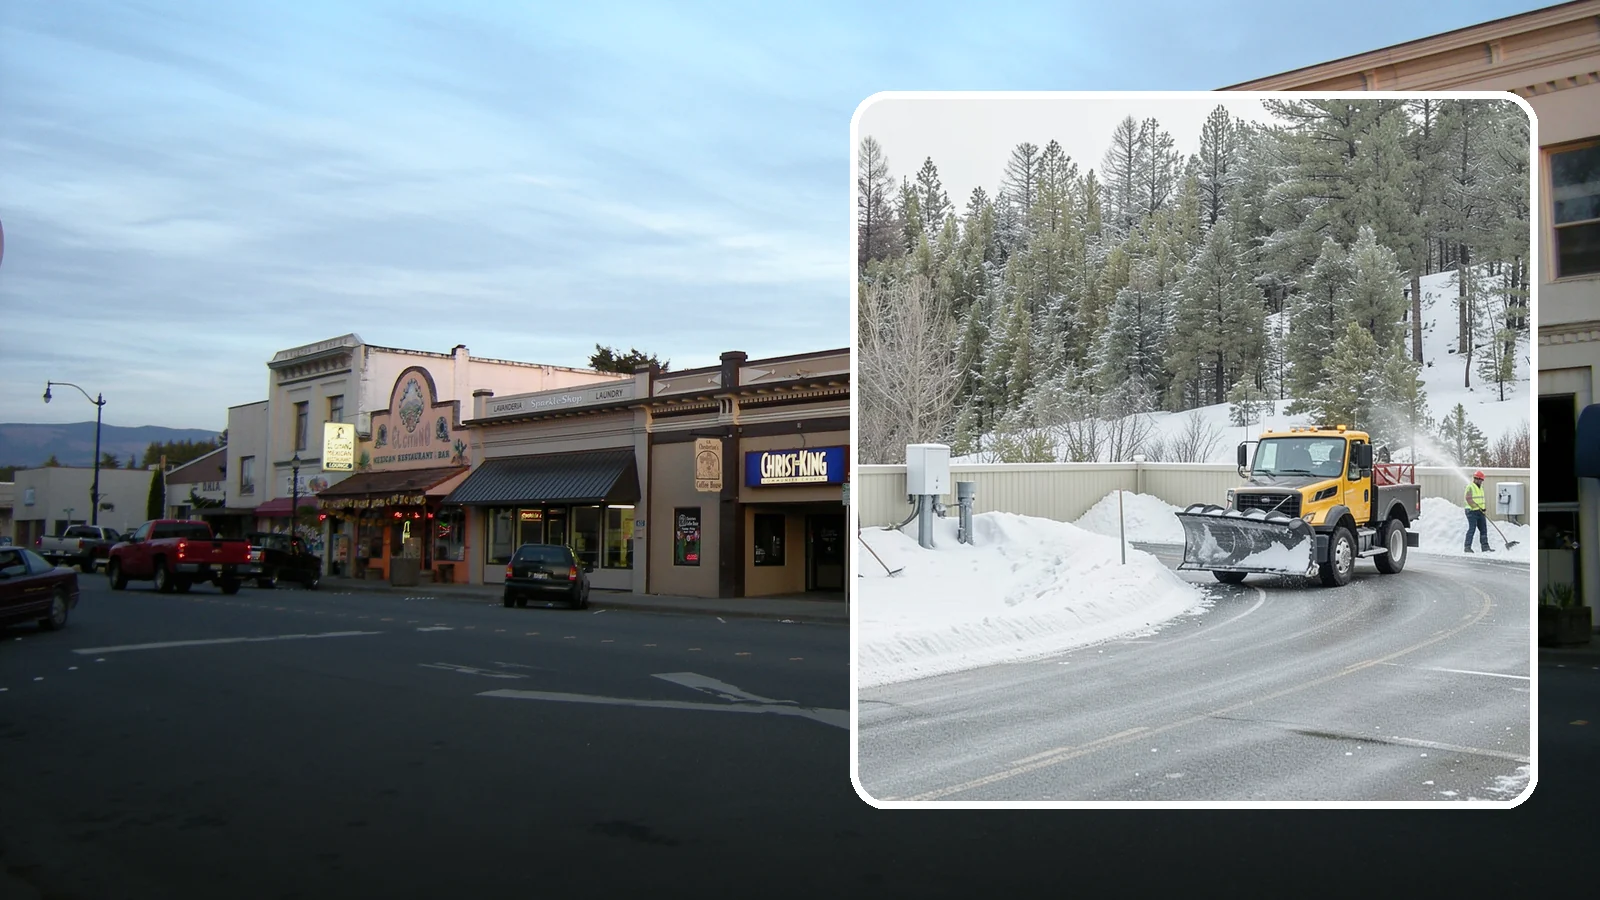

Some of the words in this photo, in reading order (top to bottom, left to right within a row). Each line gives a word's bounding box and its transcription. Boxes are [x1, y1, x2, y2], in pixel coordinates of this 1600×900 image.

[531, 395, 560, 408] Sparkle
[561, 394, 582, 404] Shop
[595, 389, 623, 400] LAUNDRY
[493, 402, 522, 413] LAVANDERIA
[374, 455, 396, 464] MEXICAN
[398, 451, 434, 462] RESTAURANT
[438, 450, 450, 459] BAR
[761, 452, 797, 478] CHRIST
[799, 450, 827, 476] KING
